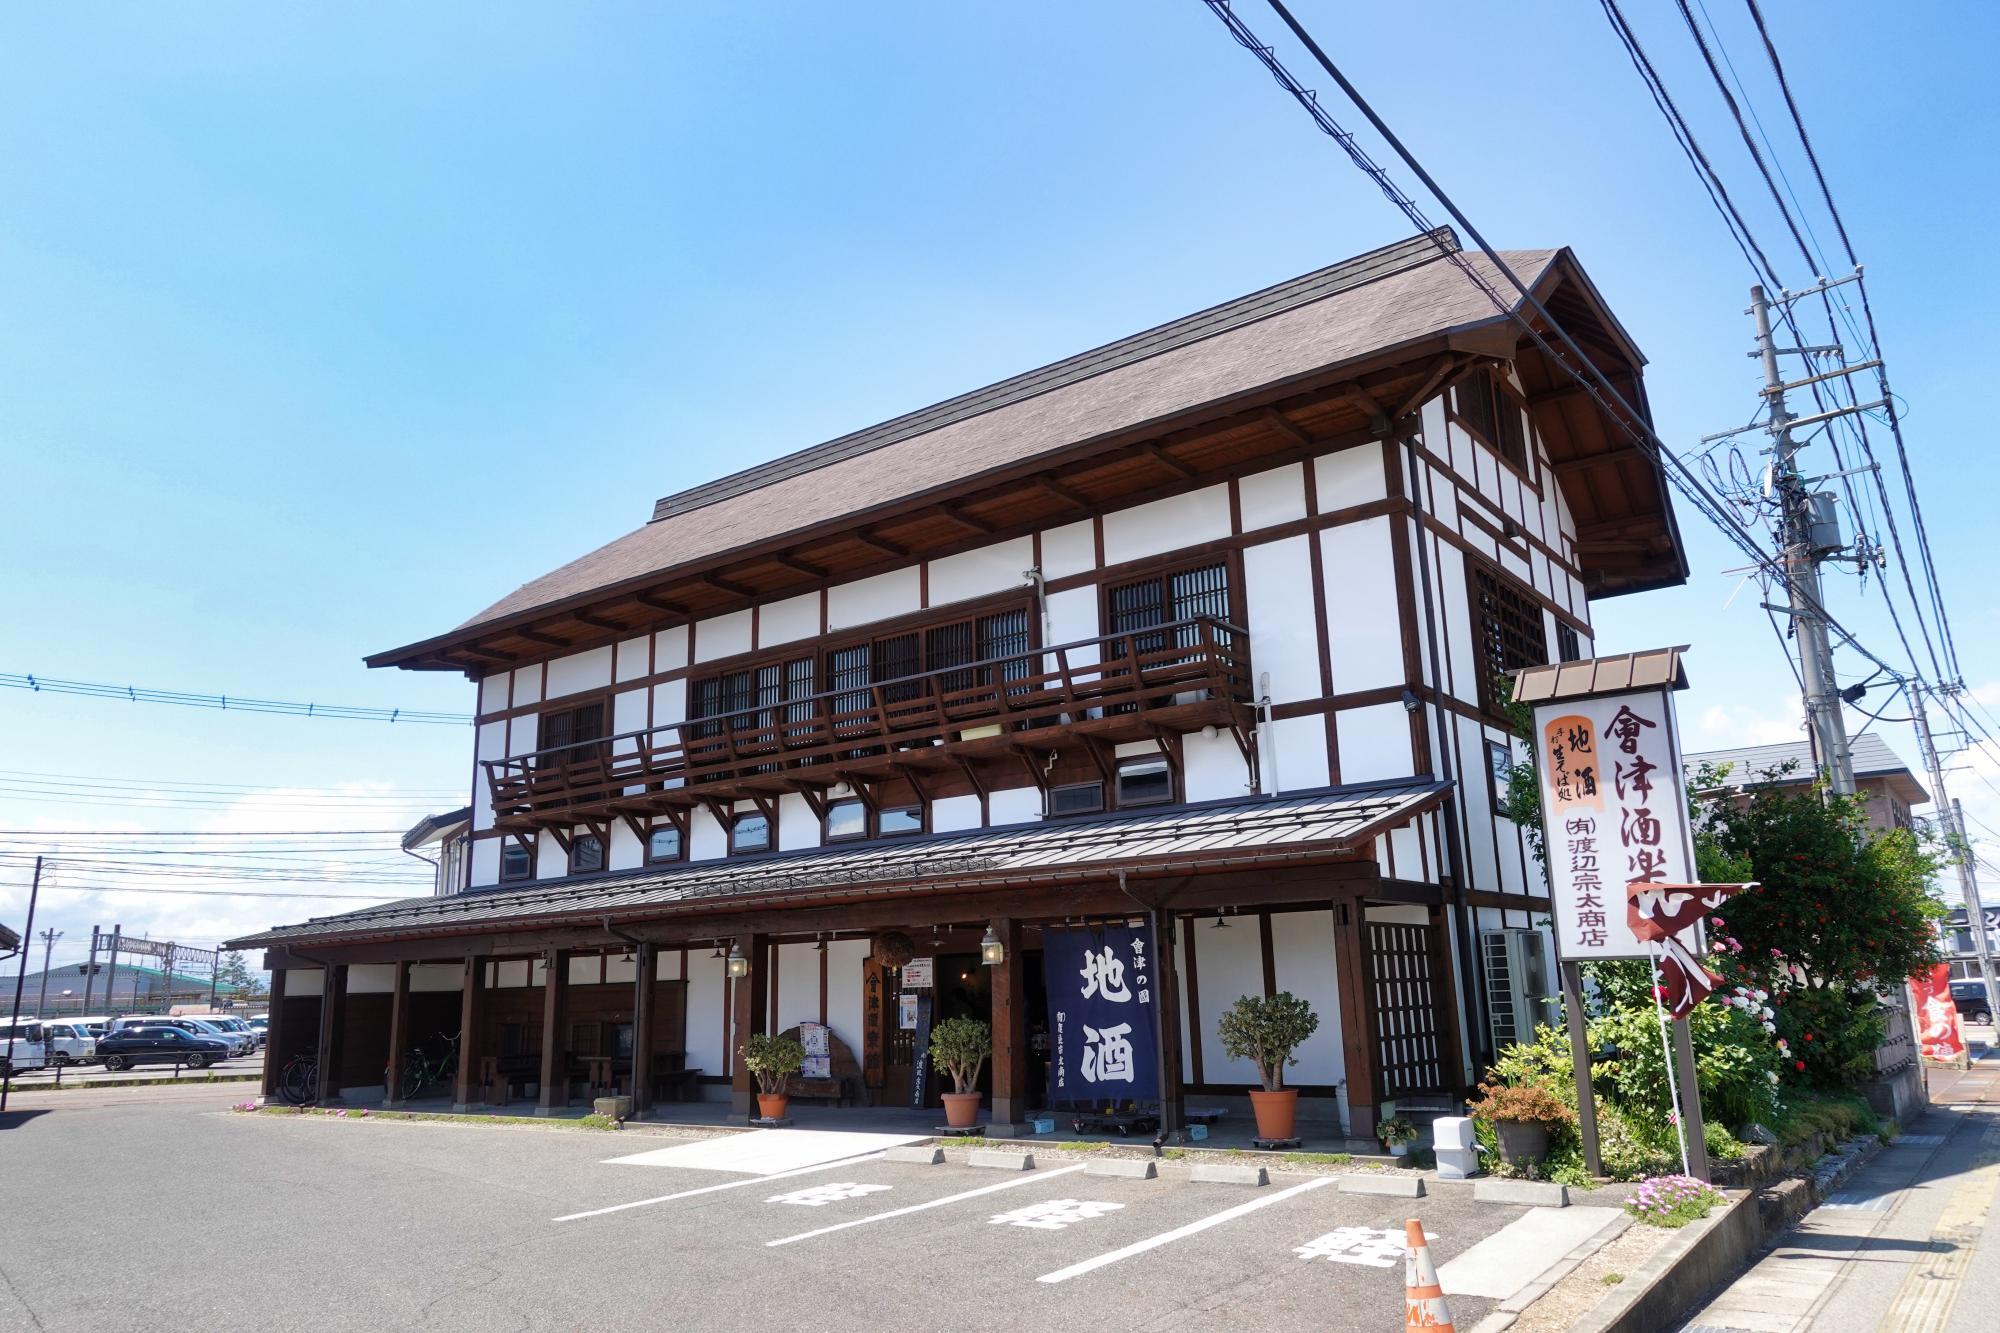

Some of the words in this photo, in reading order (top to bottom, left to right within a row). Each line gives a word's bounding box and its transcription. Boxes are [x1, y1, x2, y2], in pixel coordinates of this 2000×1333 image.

[1568, 725, 1597, 799] 地酒
[1604, 705, 1669, 886] 會津酒楽
[1079, 945, 1135, 1083] 地酒
